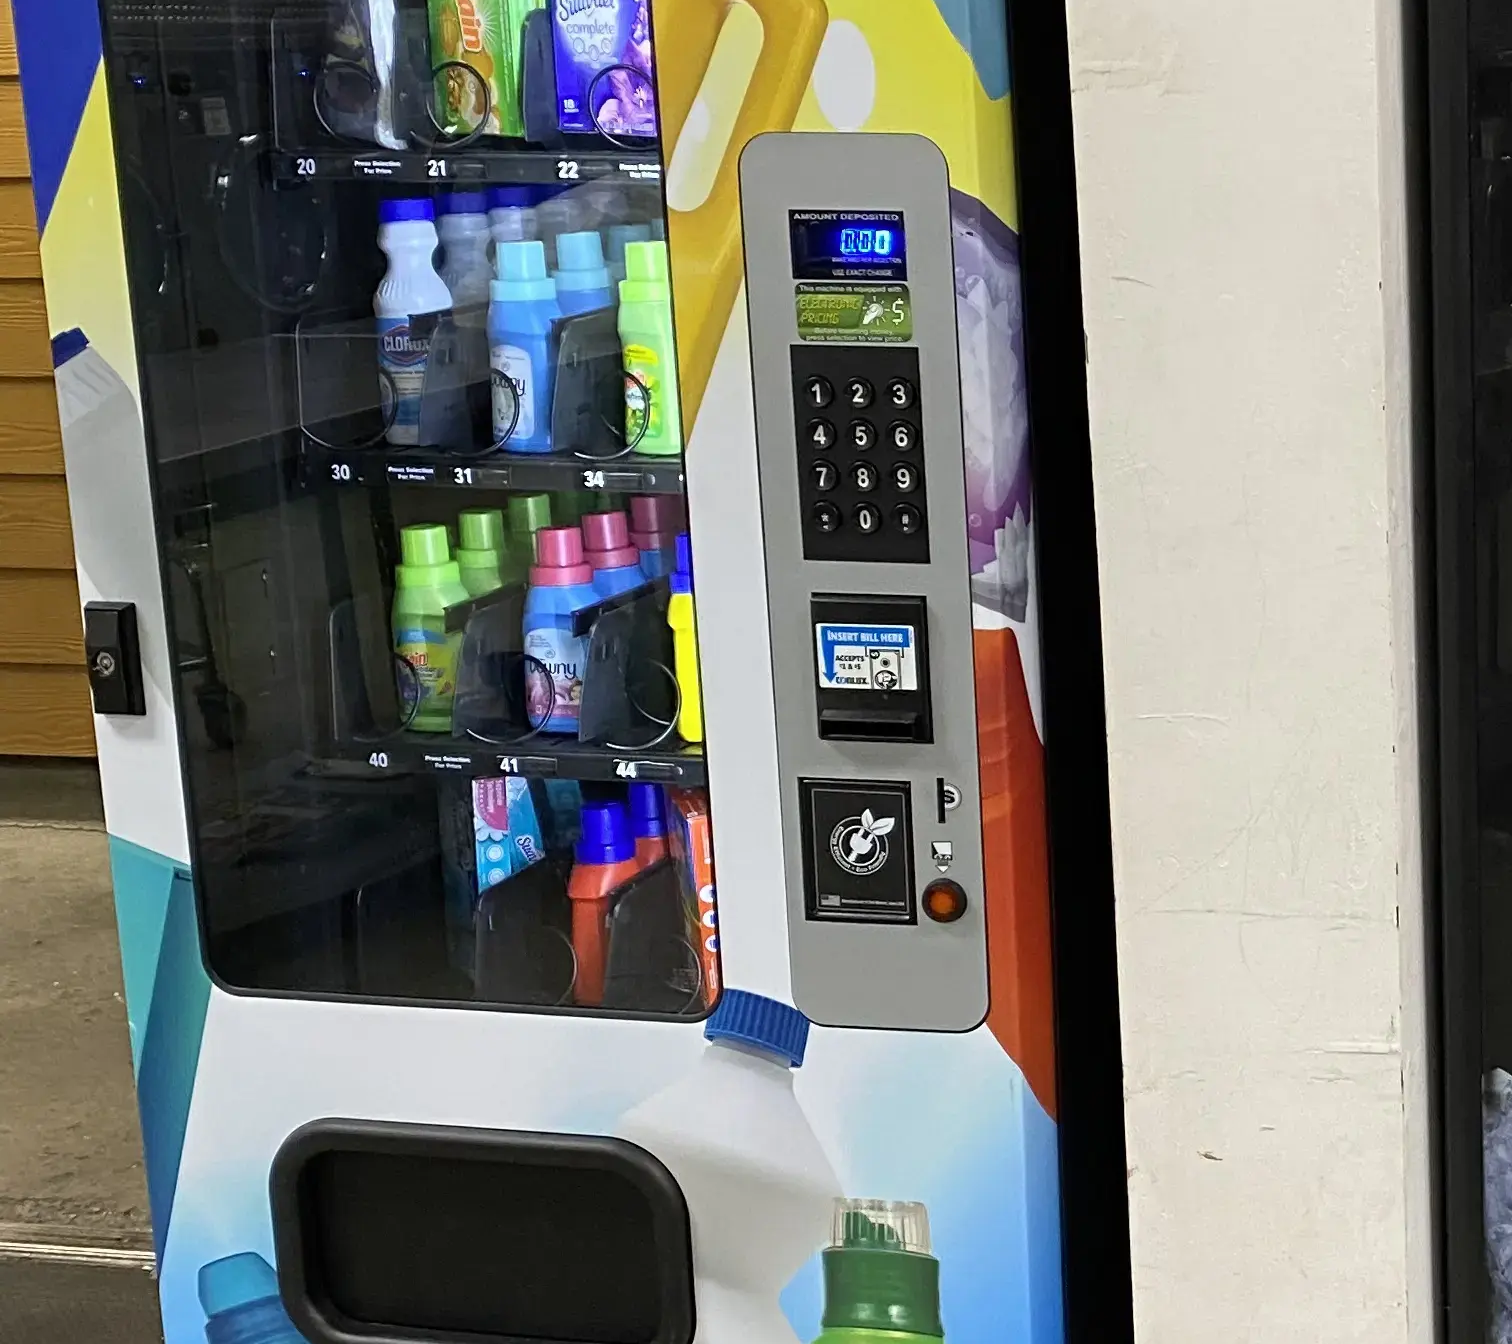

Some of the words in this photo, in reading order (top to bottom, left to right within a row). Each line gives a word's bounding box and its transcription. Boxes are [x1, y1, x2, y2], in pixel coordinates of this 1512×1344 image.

[566, 21, 615, 40] complete
[296, 158, 316, 175] 20
[427, 159, 446, 177] 21
[557, 161, 579, 179] 22
[793, 213, 837, 221] AMOUNT
[840, 213, 899, 221] DEPOSITED
[799, 298, 860, 310] ELECTRONIC
[800, 311, 839, 324] PRICING
[811, 383, 821, 404] 1
[851, 383, 864, 404] 2
[892, 383, 906, 404] 3
[813, 425, 826, 447] 4
[855, 425, 867, 447] 5
[894, 425, 908, 447] 6
[331, 464, 350, 480] 30
[454, 467, 473, 484] 31
[584, 470, 605, 488] 34
[815, 467, 827, 488] 7
[857, 467, 869, 488] 8
[896, 467, 910, 488] 9
[859, 509, 872, 530] 0
[827, 630, 859, 643] INSERT
[860, 632, 879, 643] BILL
[880, 633, 904, 644] HERE
[368, 753, 388, 768] 40
[500, 758, 519, 773] 41
[616, 761, 637, 779] 44
